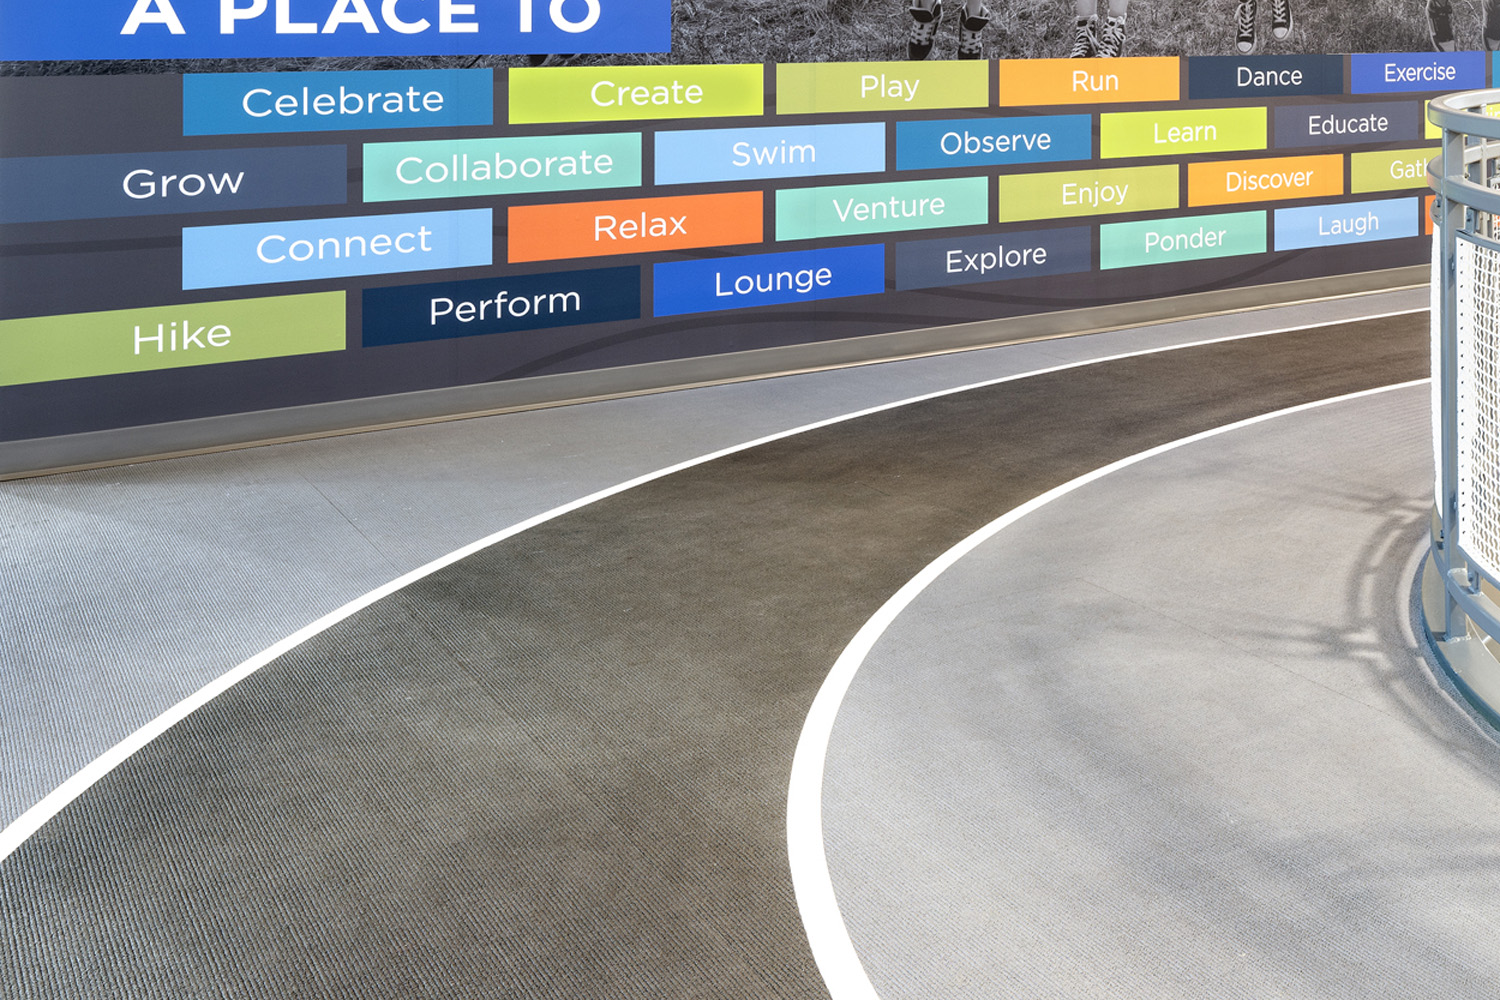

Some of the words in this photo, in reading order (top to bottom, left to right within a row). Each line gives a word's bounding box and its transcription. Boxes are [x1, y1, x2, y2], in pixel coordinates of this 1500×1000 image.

[1073, 71, 1118, 91] Run
[1238, 67, 1302, 86] Dance
[1386, 64, 1455, 81] Exercise
[591, 81, 703, 106] Create
[862, 74, 919, 101] Play
[243, 86, 443, 117] Celebrate
[1155, 123, 1216, 143] Learn
[1310, 114, 1388, 134] Educate
[733, 142, 815, 166] Swim
[941, 131, 1050, 154] Observe
[397, 151, 612, 184] Collaborate
[123, 170, 244, 198] Grow
[1227, 171, 1313, 191] Discover
[1063, 183, 1128, 207] Enjoy
[833, 197, 944, 221] Venture
[595, 212, 686, 240] Relax
[1320, 212, 1378, 235] Laugh
[257, 226, 431, 263] Connect
[1146, 227, 1226, 252] Ponder
[947, 246, 1046, 274] Explore
[717, 268, 831, 296] Lounge
[432, 291, 579, 324] Perform
[135, 320, 231, 354] Hike
